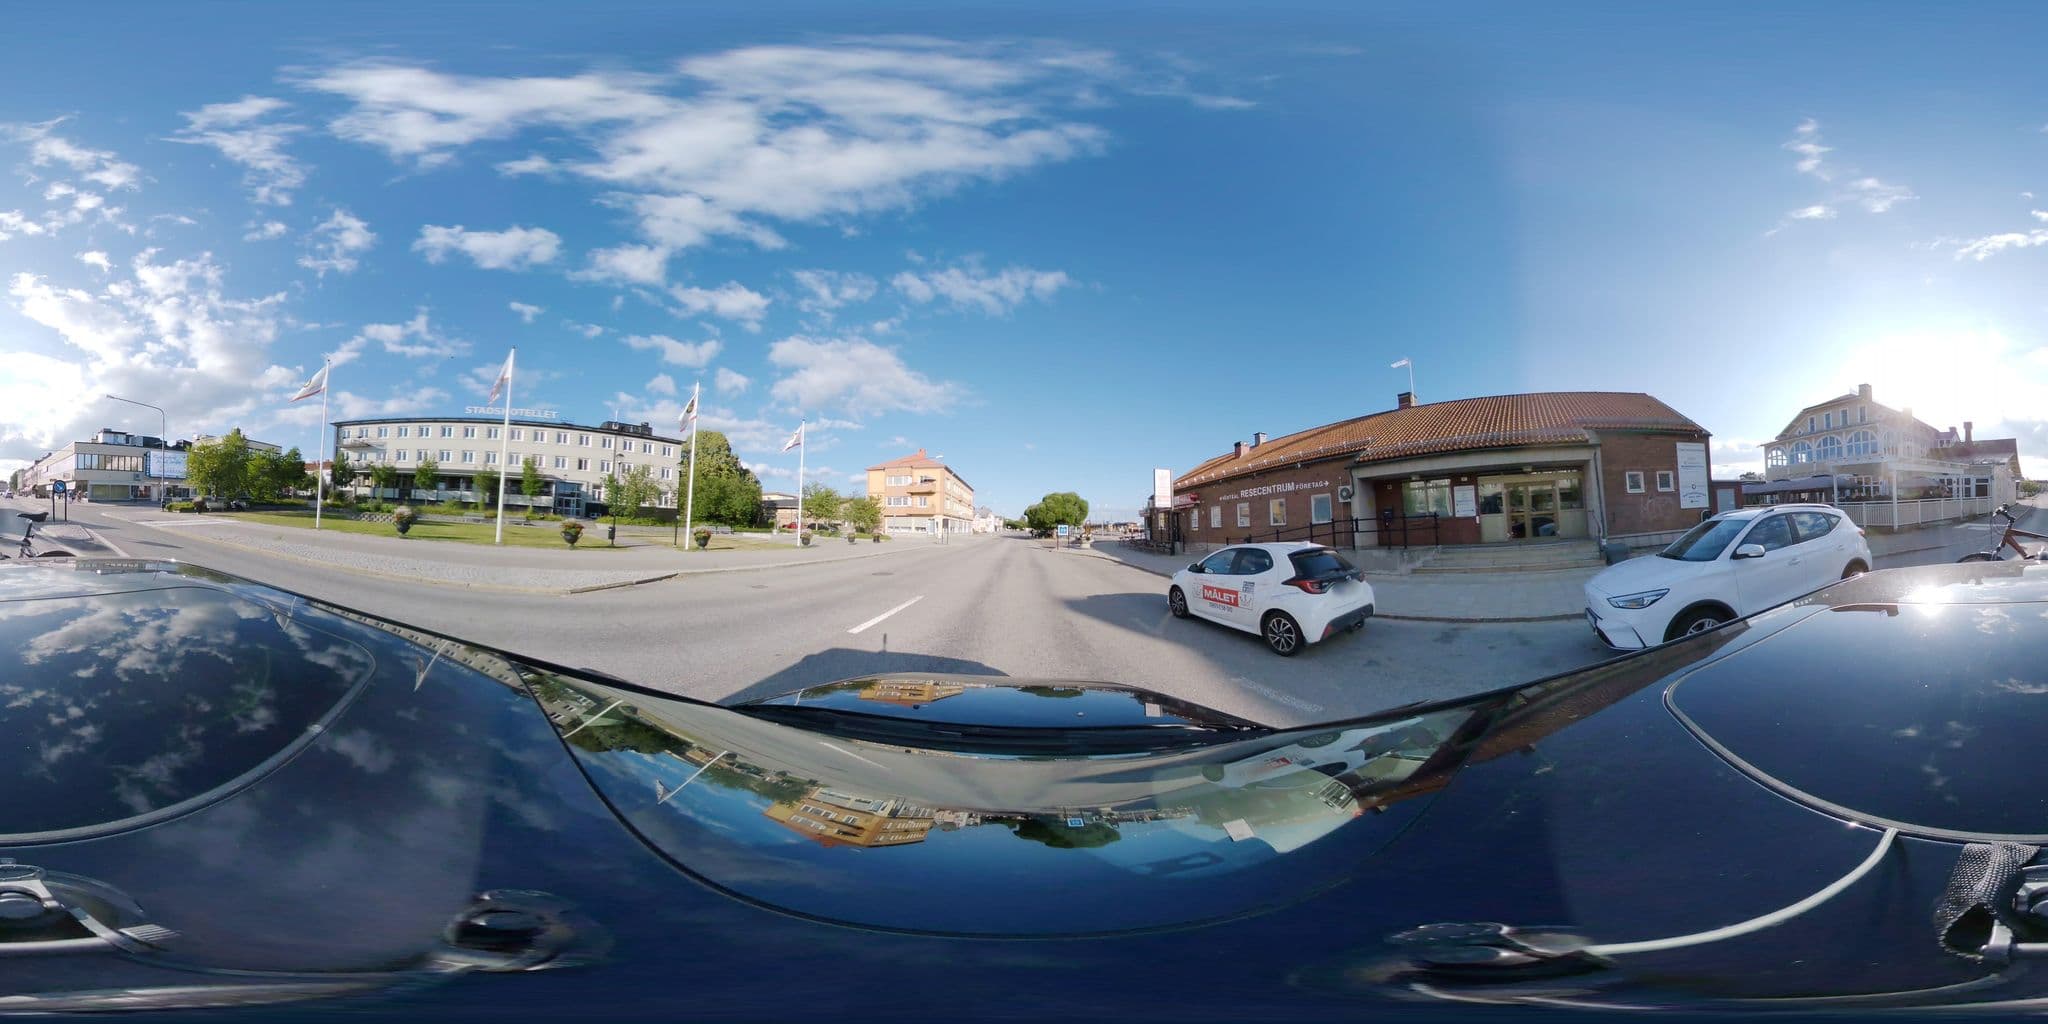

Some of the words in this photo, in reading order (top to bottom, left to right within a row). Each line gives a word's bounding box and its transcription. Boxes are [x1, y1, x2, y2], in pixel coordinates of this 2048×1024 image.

[1240, 482, 1295, 498] RESECENTRUM
[1296, 481, 1323, 490] FÖRETAG
[1204, 589, 1236, 604] MÅLET
